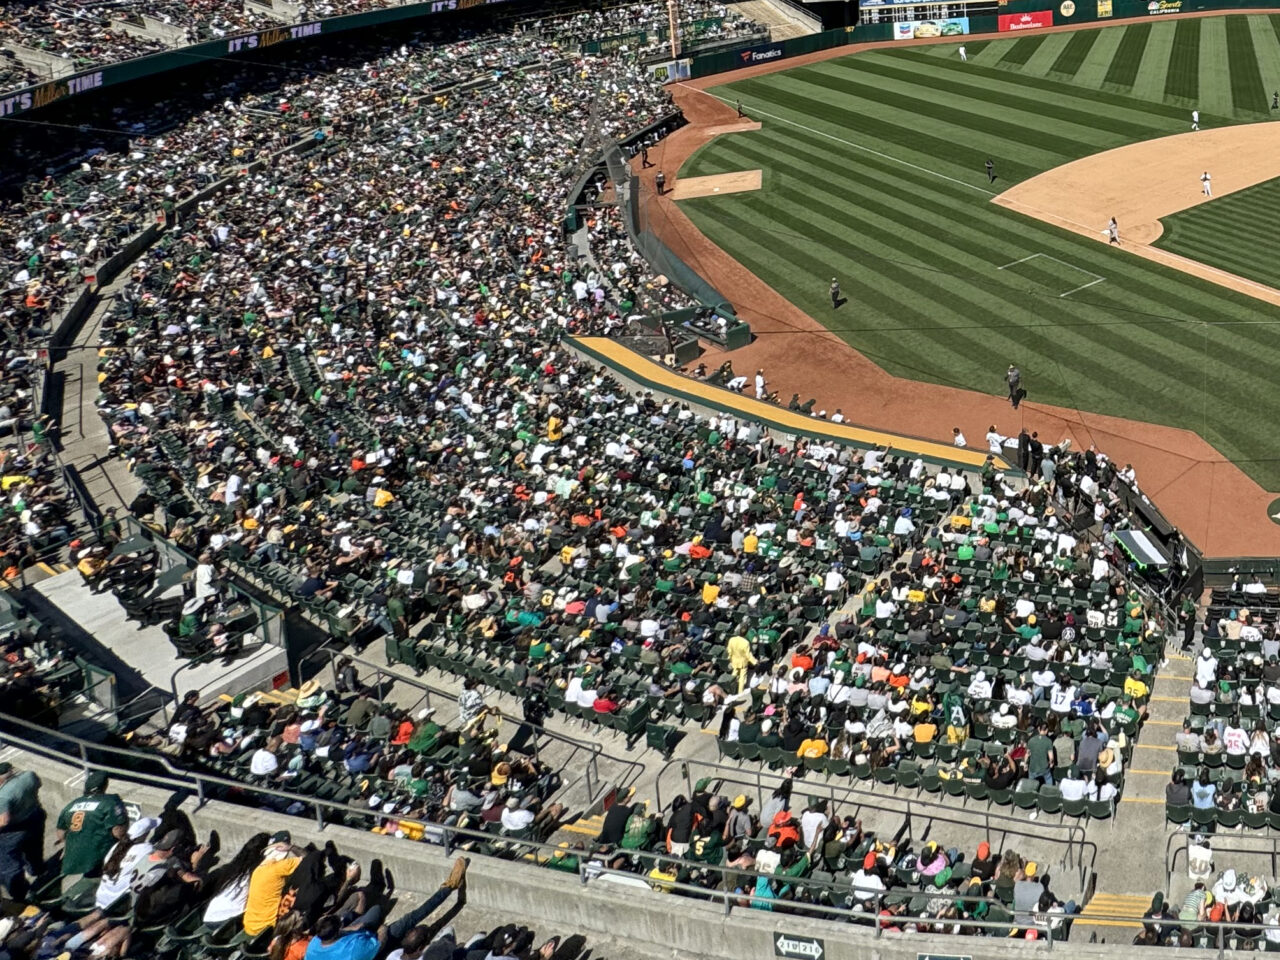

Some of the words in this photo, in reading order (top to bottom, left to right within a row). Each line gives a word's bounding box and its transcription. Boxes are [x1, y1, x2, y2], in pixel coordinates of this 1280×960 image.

[431, 0, 457, 12] IT'S
[1010, 21, 1043, 30] Budweiser
[228, 35, 258, 53] IT'S
[290, 23, 322, 38] TIME
[752, 49, 782, 61] Fanatics
[0, 92, 32, 118] IT'S
[67, 72, 103, 95] TIME
[1056, 694, 1066, 705] 17
[70, 811, 86, 832] 9
[695, 841, 705, 855] 5
